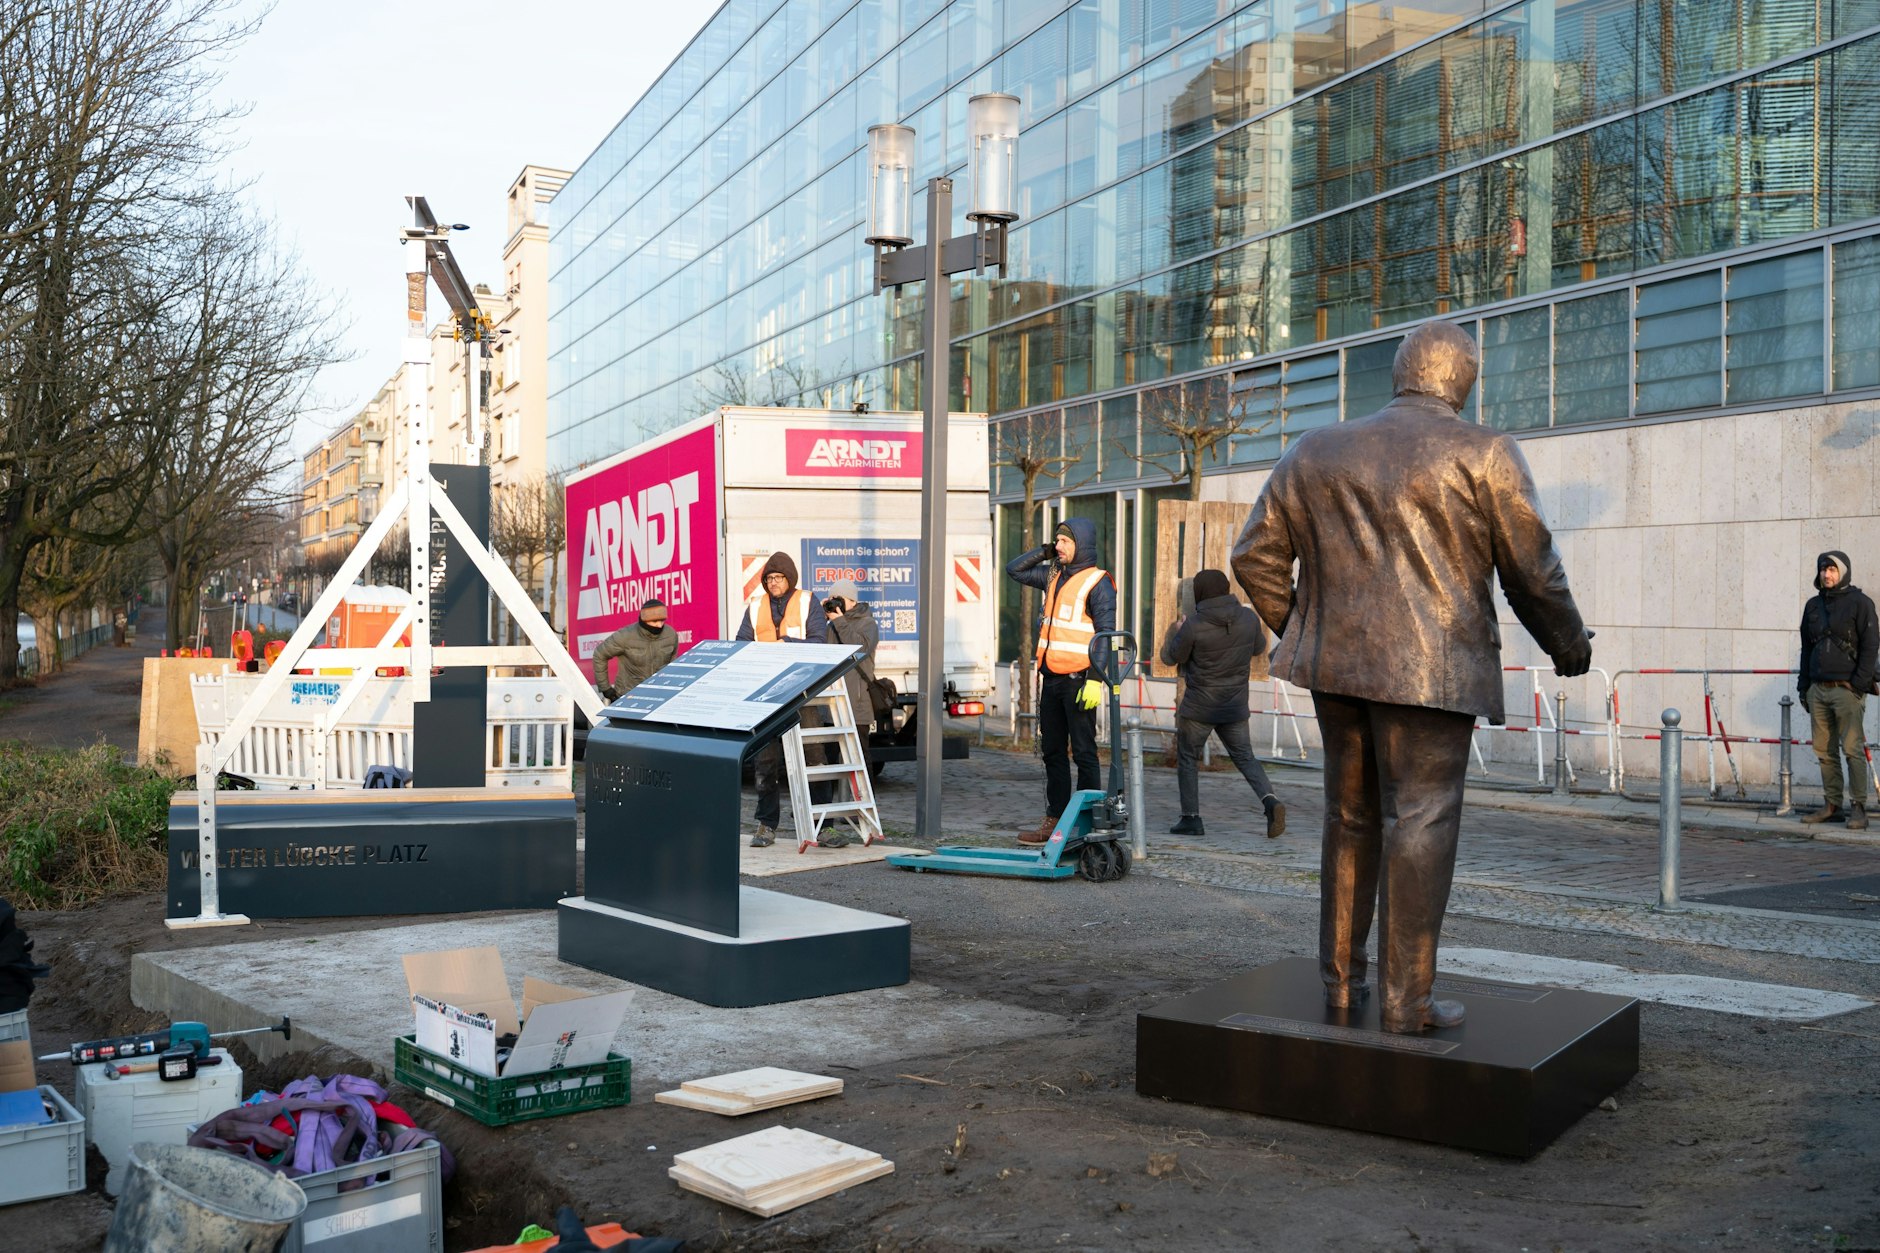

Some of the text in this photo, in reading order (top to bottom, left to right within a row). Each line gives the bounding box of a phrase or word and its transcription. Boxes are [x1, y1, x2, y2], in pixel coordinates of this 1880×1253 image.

[805, 438, 907, 468] ARNDT
[838, 459, 902, 469] FAIRMIETEN
[577, 470, 700, 620] ARNDT
[816, 546, 910, 556] Kennen Sie schon?
[815, 567, 912, 583] FRIGORENT
[610, 568, 692, 616] FAIRMIETEN
[868, 599, 916, 609] ugvermieter
[273, 842, 356, 867] LÜBCKE
[362, 844, 429, 865] PLATZ
